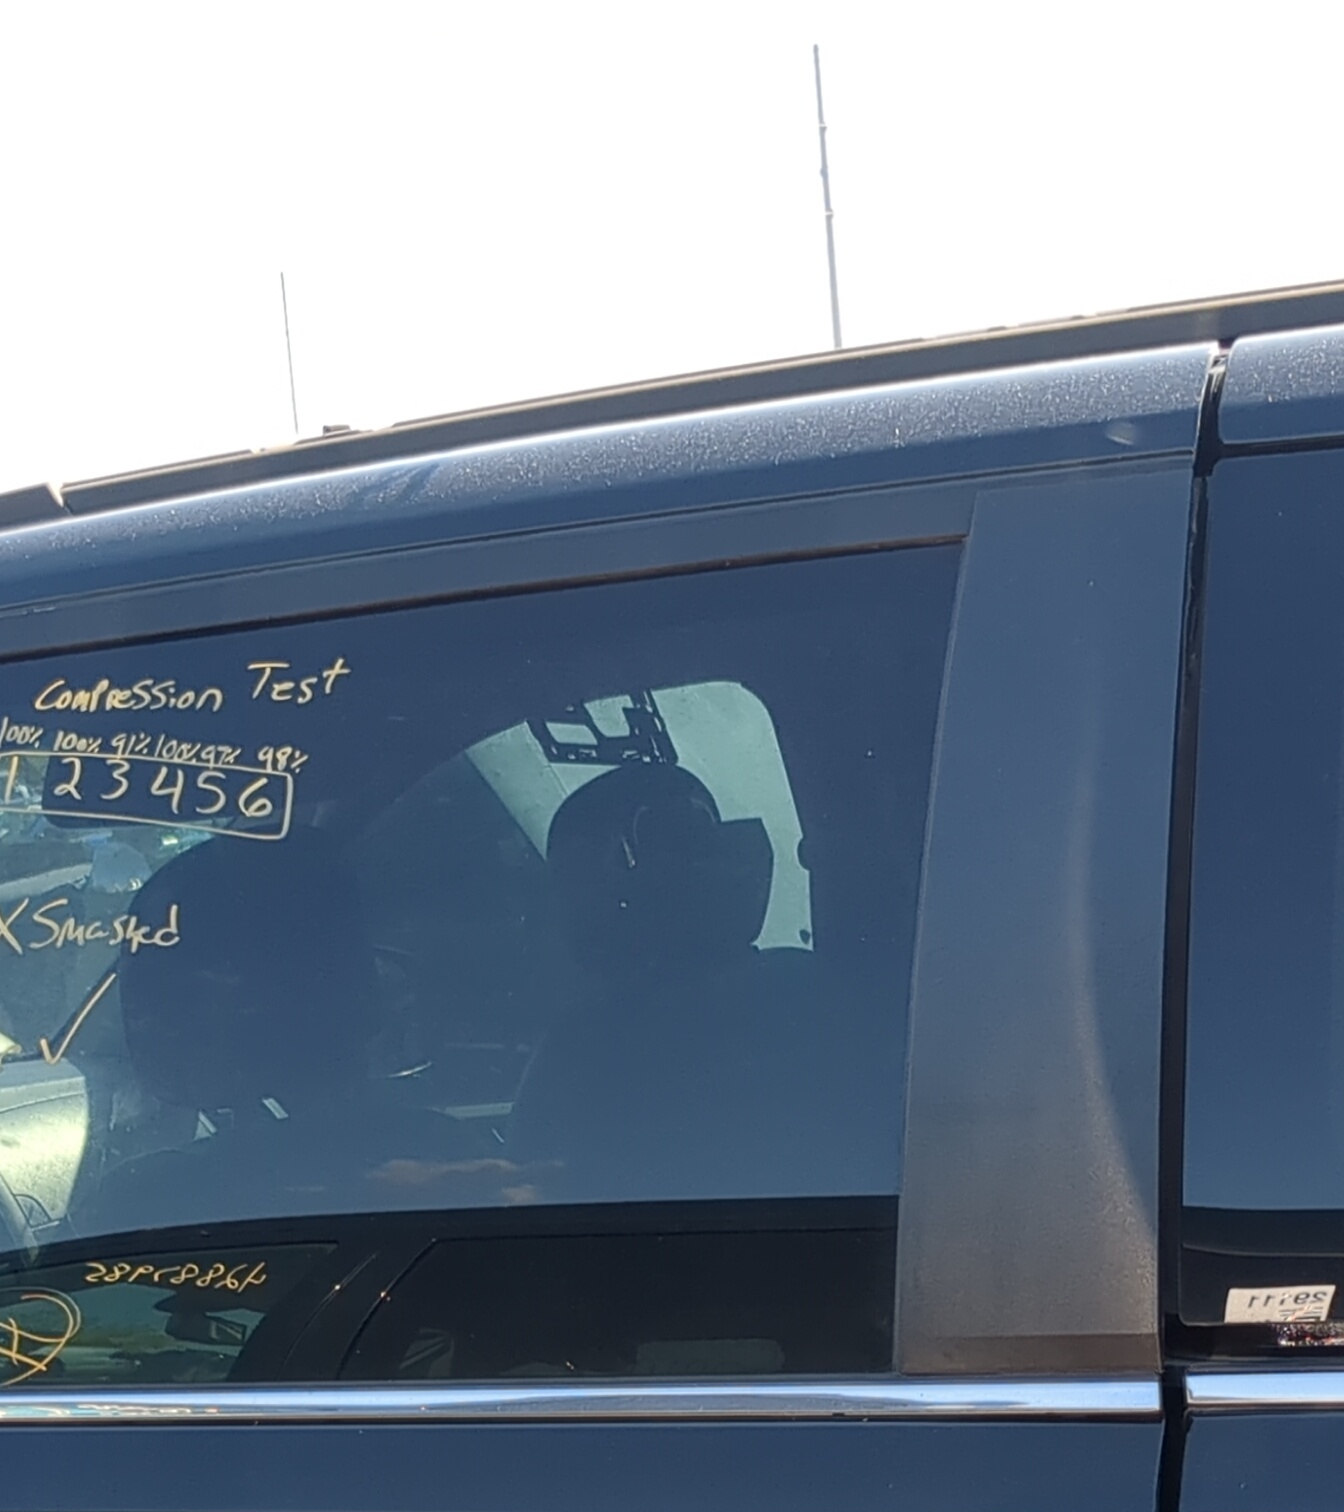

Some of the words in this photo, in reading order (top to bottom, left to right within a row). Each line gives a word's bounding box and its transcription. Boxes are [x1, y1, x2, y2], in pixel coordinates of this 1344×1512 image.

[247, 657, 352, 704] Test
[258, 745, 309, 773] 98%
[4, 755, 20, 804] 1
[53, 757, 82, 800] 2
[100, 759, 131, 799] 3
[150, 765, 185, 814] 4
[195, 770, 227, 814] 5
[238, 776, 273, 817] 6
